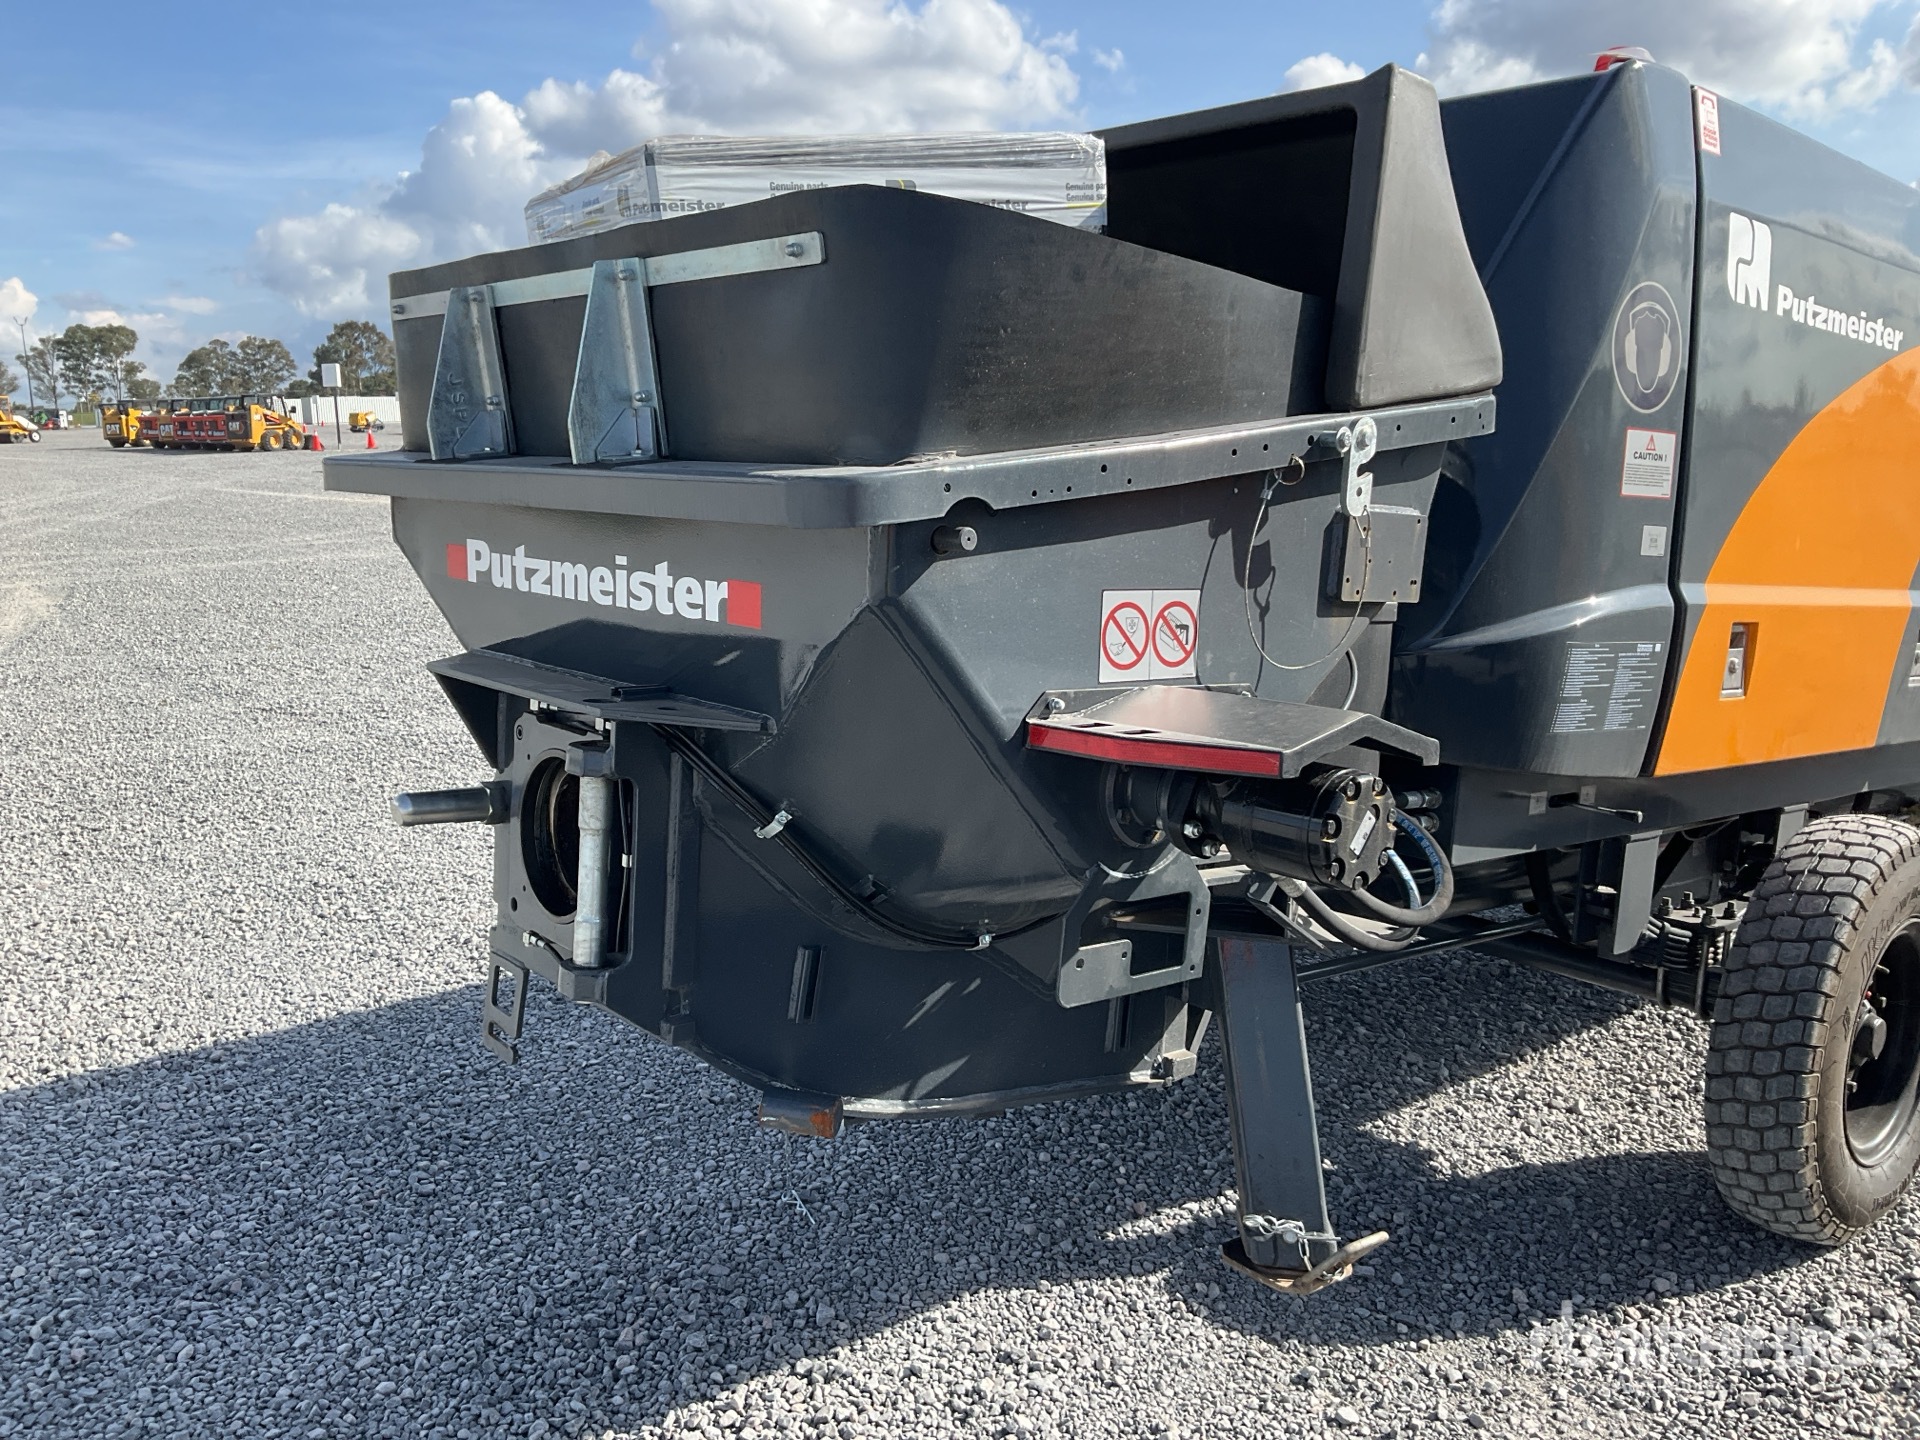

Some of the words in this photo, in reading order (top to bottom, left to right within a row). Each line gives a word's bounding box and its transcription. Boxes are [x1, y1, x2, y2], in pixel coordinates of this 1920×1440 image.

[769, 181, 804, 191] Genuine
[1065, 182, 1094, 191] Genuine
[1066, 193, 1094, 201] Genuine
[1776, 283, 1904, 351] Putzmeister
[105, 423, 120, 435] CAT
[160, 424, 173, 437] CAT
[228, 421, 240, 431] CAT
[1633, 451, 1663, 462] CAUTION
[465, 538, 729, 622] Putzmeister
